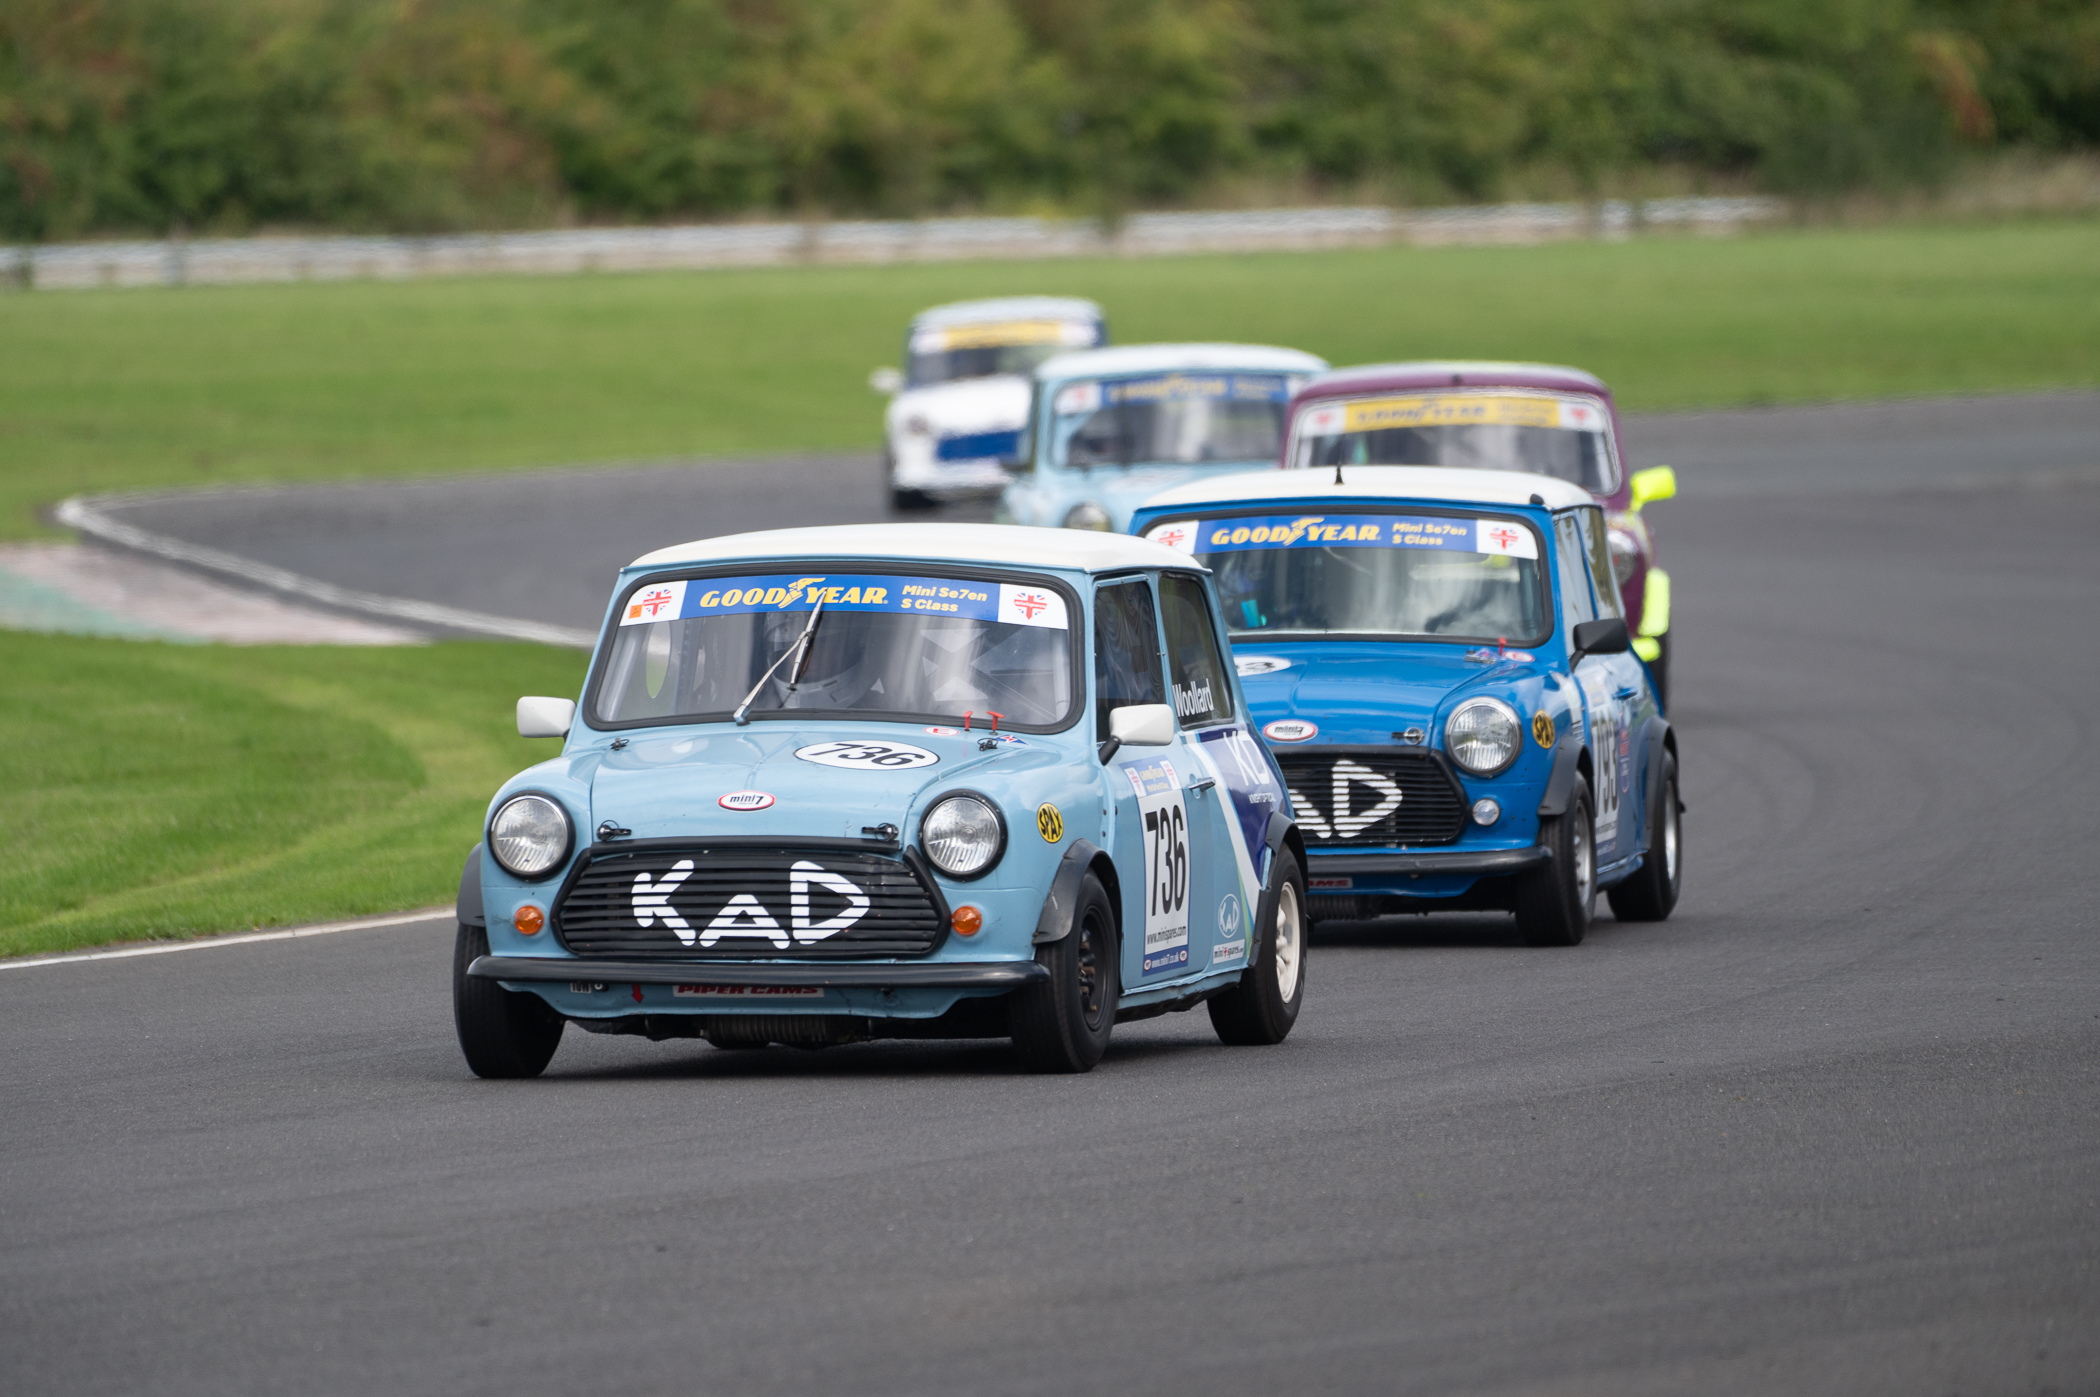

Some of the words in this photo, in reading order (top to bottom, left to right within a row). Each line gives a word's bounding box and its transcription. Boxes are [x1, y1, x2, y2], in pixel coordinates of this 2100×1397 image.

[1392, 523, 1423, 533] Mini
[1425, 525, 1467, 536] Se7en
[1392, 534, 1402, 544] S
[1404, 535, 1443, 545] Class
[901, 598, 912, 609] S
[914, 599, 958, 612] Class
[902, 585, 935, 597] Mini
[938, 587, 987, 602] Se7en
[1172, 678, 1214, 717] Woollard
[808, 743, 926, 767] 736
[1288, 759, 1403, 838] AD
[1039, 806, 1062, 840] SPAX
[1145, 804, 1186, 917] 736
[631, 859, 871, 950] KAD
[1220, 901, 1239, 932] KAD
[1147, 925, 1187, 945] www.minispares.com
